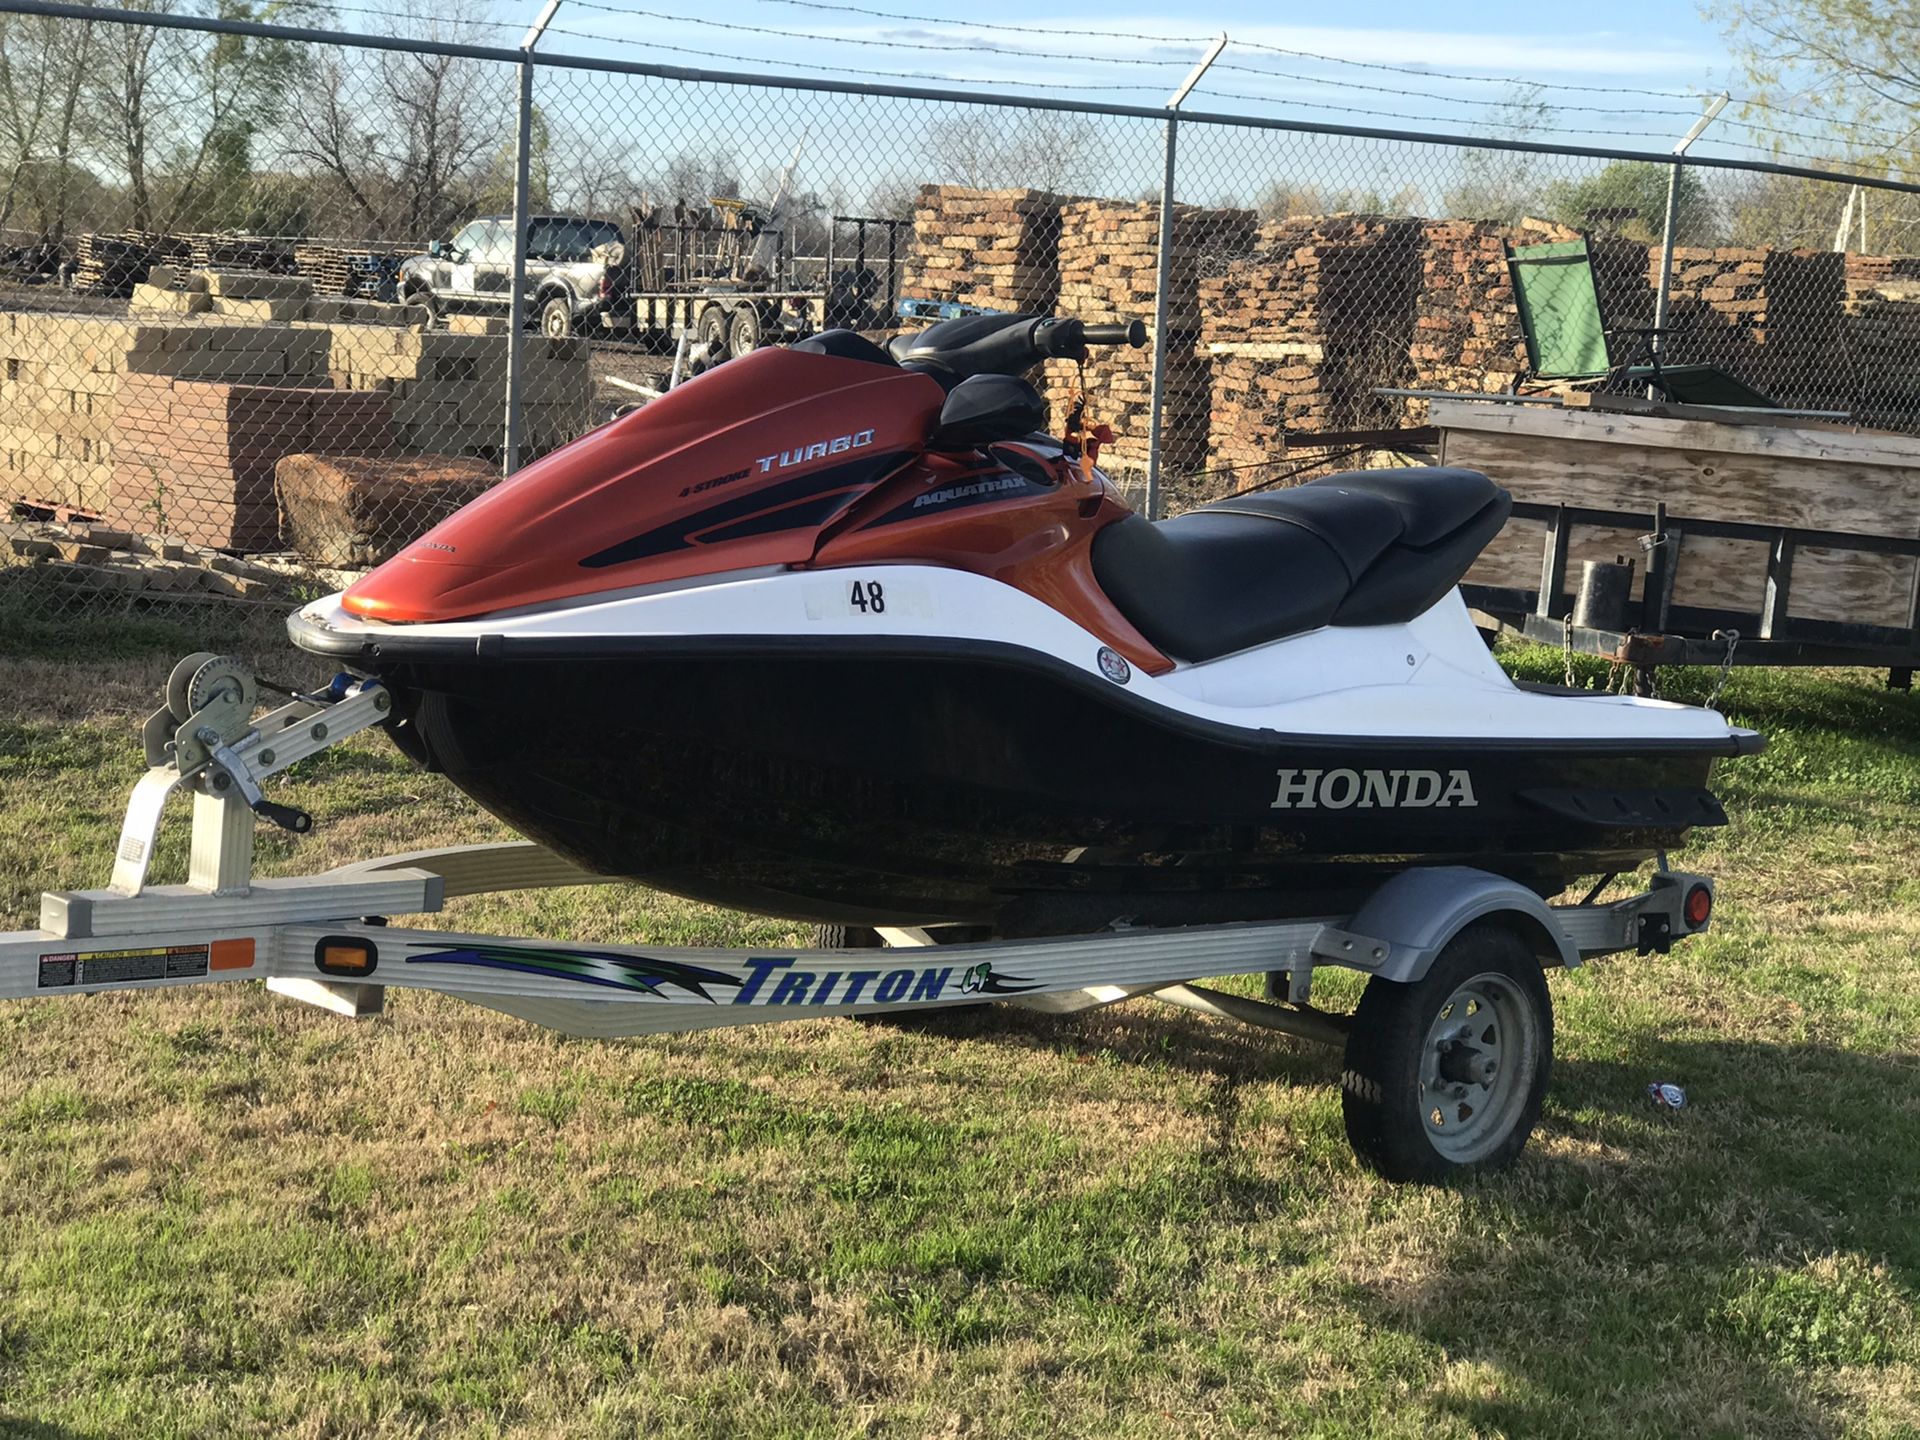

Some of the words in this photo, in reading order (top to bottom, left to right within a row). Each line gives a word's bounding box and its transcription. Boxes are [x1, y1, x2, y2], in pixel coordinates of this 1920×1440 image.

[755, 429, 875, 473] TURBO
[850, 580, 885, 613] 48
[1270, 768, 1479, 808] HONDA
[49, 954, 75, 962] DANGER
[732, 957, 953, 1005] TRITON
[961, 962, 992, 994] LT
